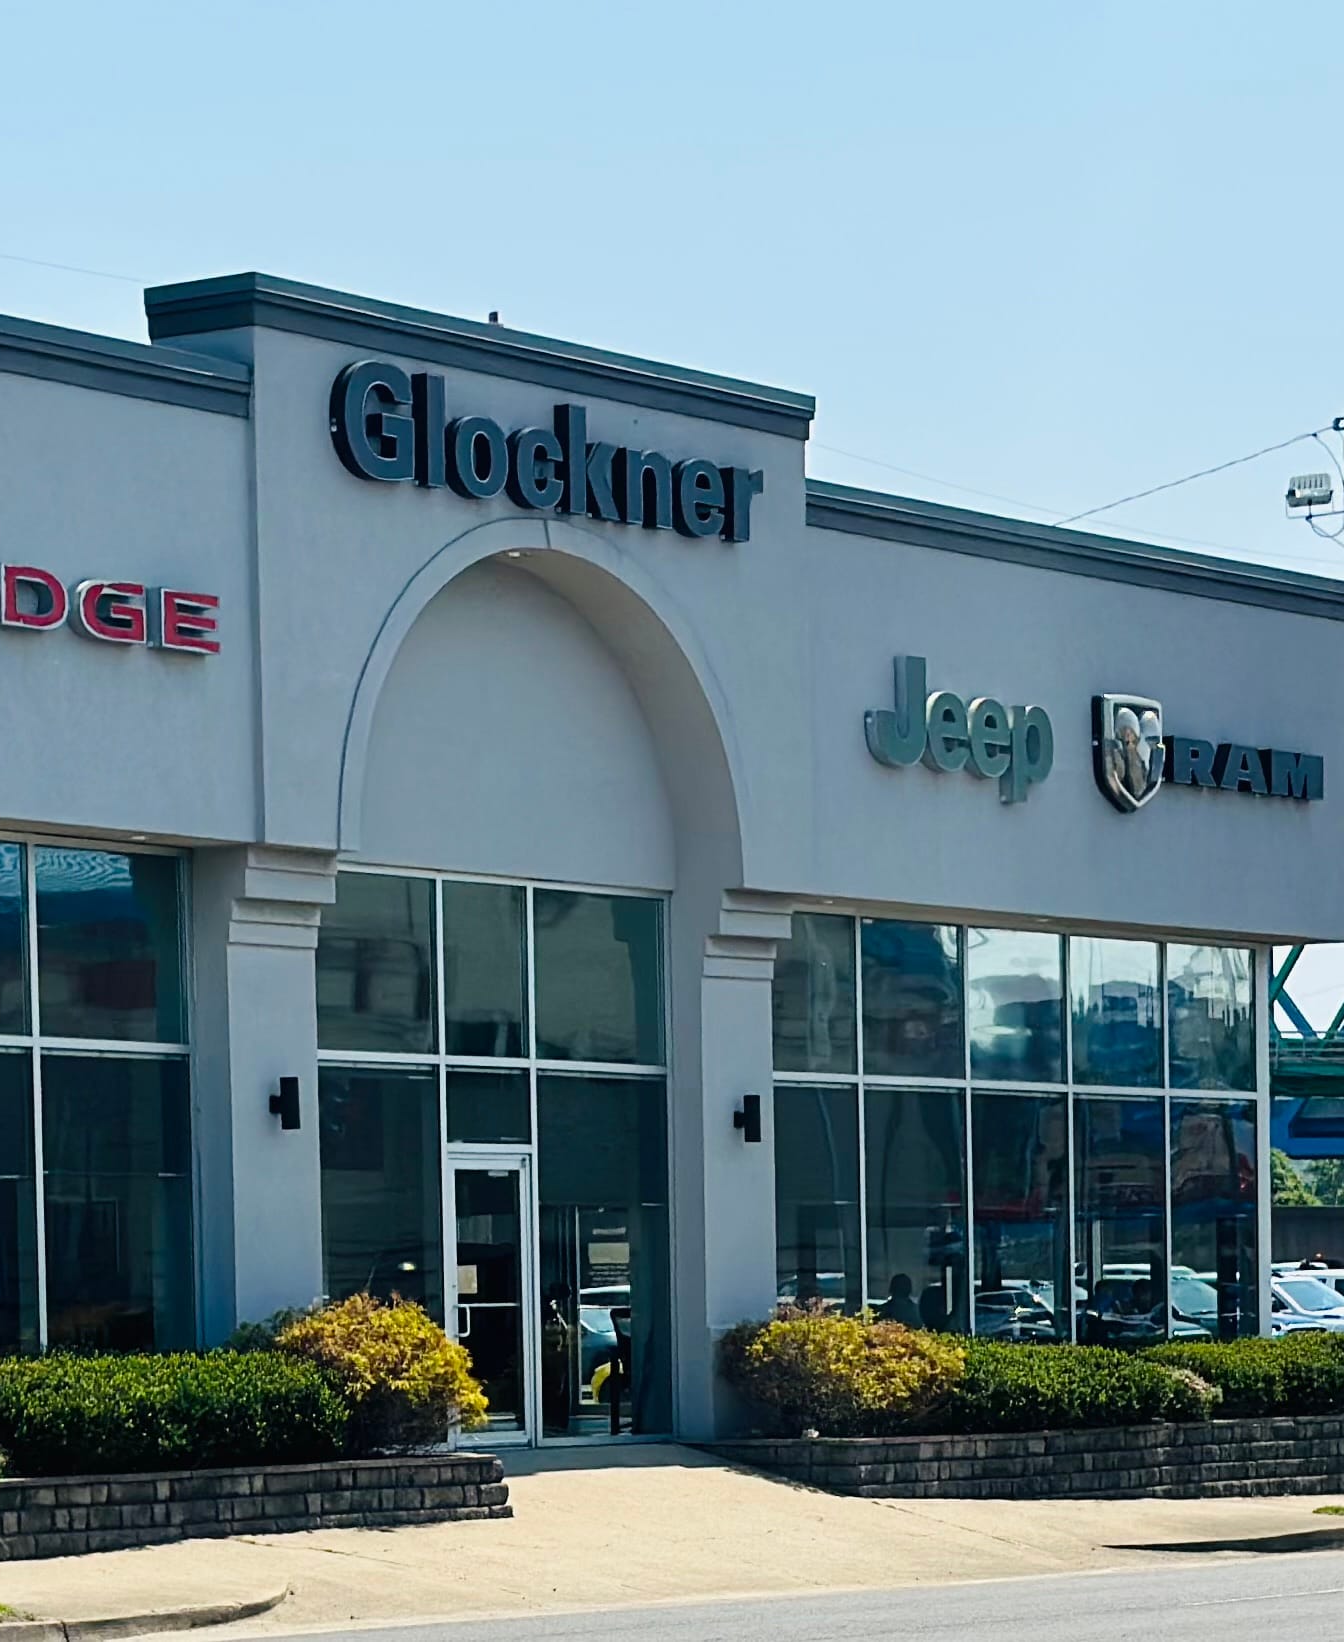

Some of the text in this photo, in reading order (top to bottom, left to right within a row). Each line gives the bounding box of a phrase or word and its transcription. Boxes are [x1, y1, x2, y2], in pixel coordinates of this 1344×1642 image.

[329, 359, 763, 543] Glockner
[864, 656, 1054, 804] Jeep
[1163, 734, 1324, 801] RAM
